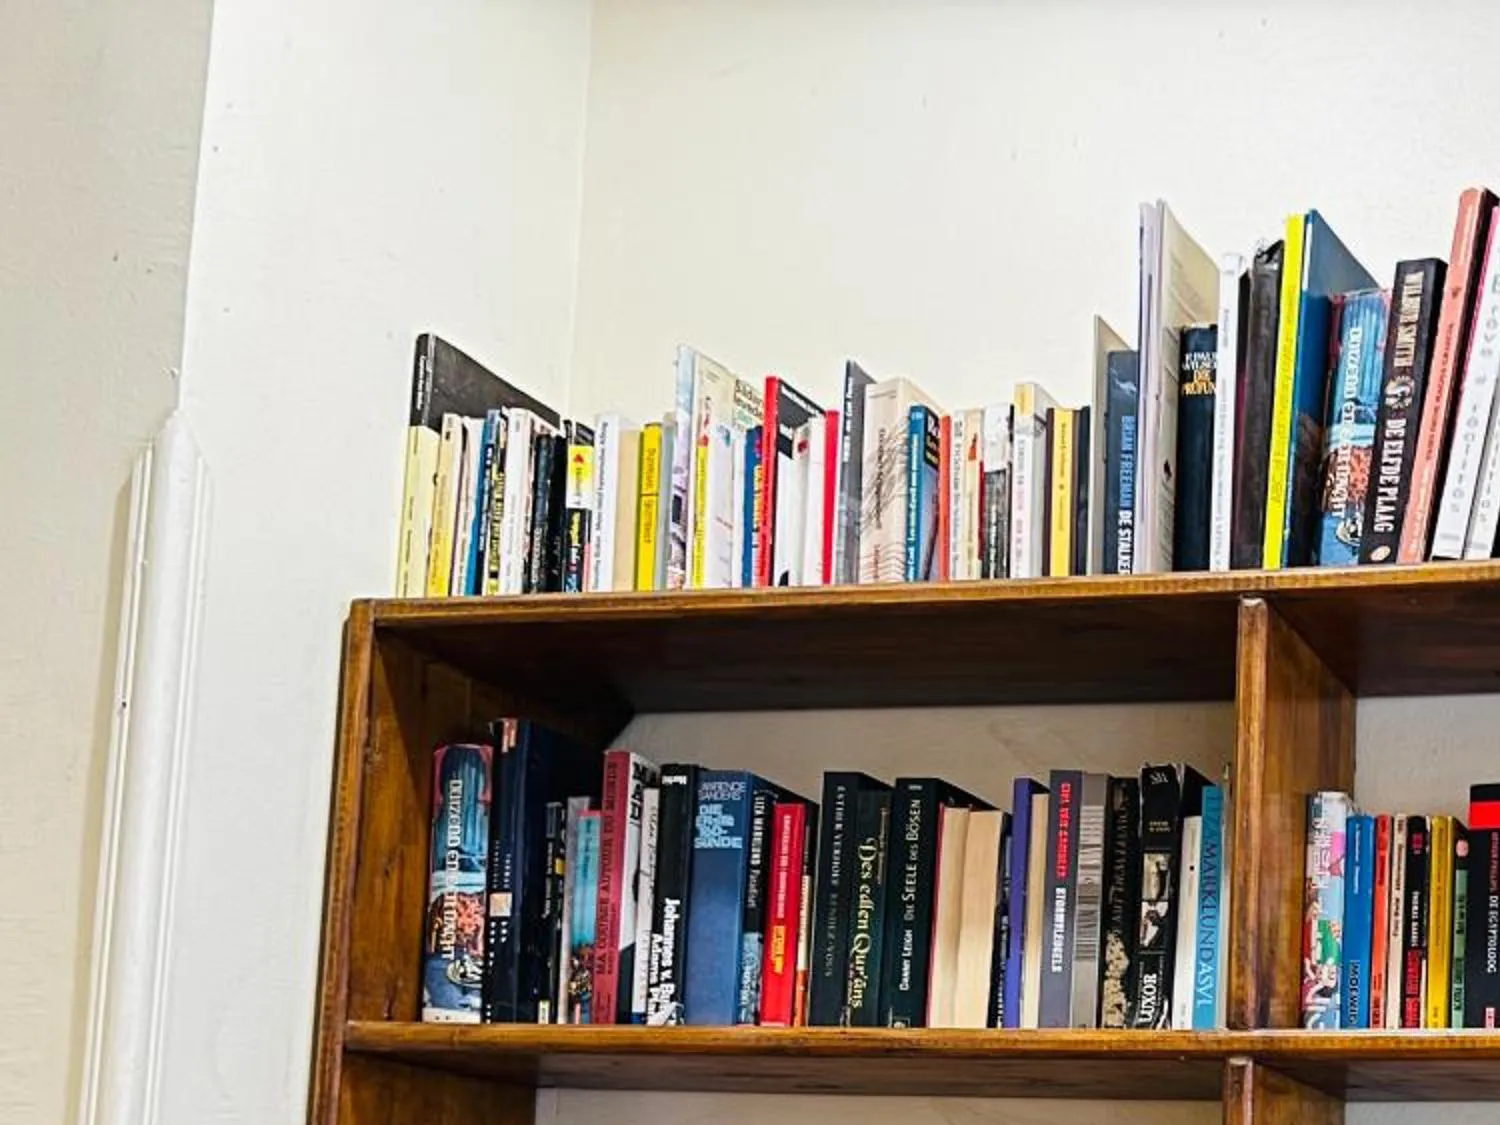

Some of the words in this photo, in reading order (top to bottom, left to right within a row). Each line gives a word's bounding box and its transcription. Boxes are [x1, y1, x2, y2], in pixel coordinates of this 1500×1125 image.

[1400, 271, 1424, 324] WILBUR
[1393, 327, 1417, 367] SMITH
[1121, 416, 1134, 450] BRIAN
[1385, 420, 1406, 438] DE
[1119, 454, 1132, 506] FREEMAN
[1379, 441, 1404, 484] ELFDE
[1119, 511, 1131, 525] DE
[1373, 488, 1396, 532] PLAAG
[906, 800, 921, 840] BÖSEN
[858, 837, 877, 879] Des
[902, 864, 917, 901] SEELE
[1200, 842, 1219, 961] MARKLUND
[1488, 896, 1499, 908] DE
[858, 885, 874, 930] edlen
[661, 899, 680, 967] Johannes
[901, 930, 913, 956] LEIGH
[1137, 974, 1157, 1023] LUXOR
[1196, 962, 1213, 1007] ASYL
[1347, 964, 1362, 1023] MOEWIG
